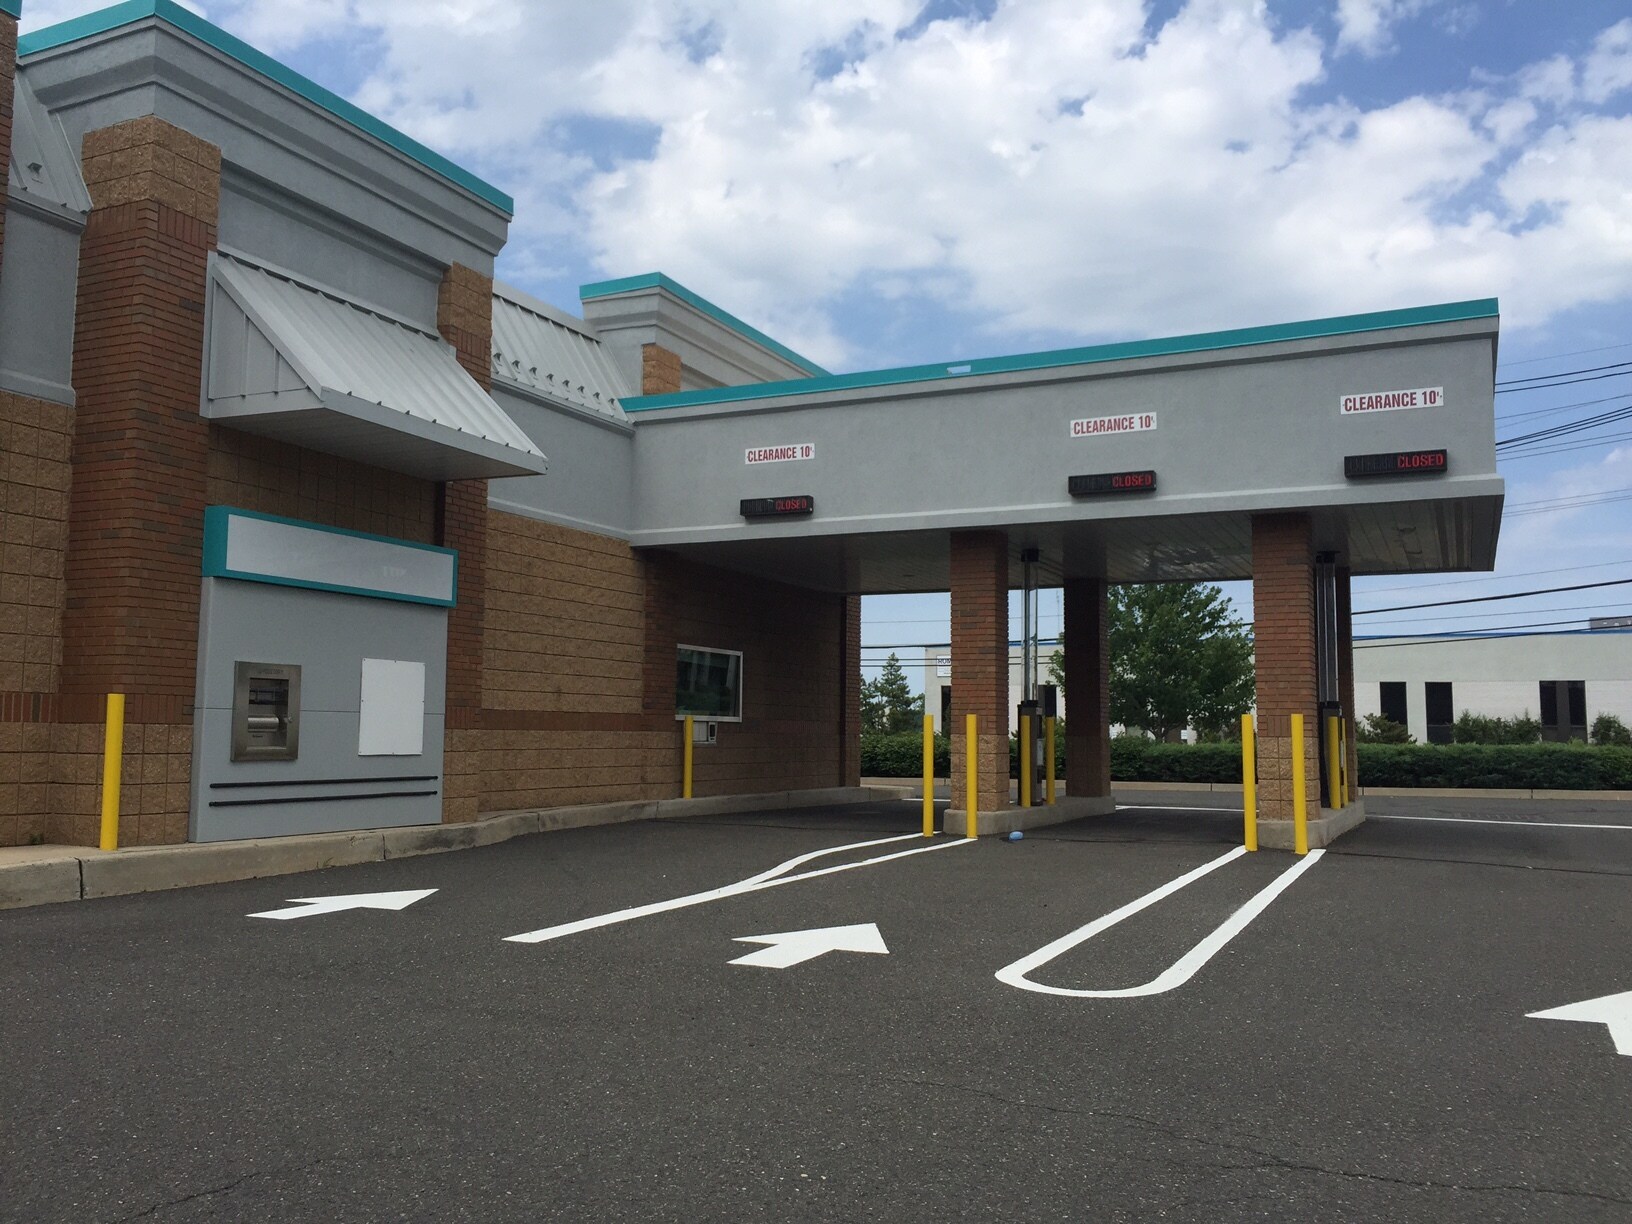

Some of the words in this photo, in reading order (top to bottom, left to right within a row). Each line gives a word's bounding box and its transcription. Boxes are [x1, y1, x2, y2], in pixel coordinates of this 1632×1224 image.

[1344, 392, 1417, 412] CLEARANCE
[1073, 416, 1135, 435] CLEARANCE
[747, 447, 797, 462] CLEARANCE
[1397, 453, 1444, 469] CLOSED
[1112, 474, 1152, 488] CLOSED
[775, 498, 807, 511] CLOSED
